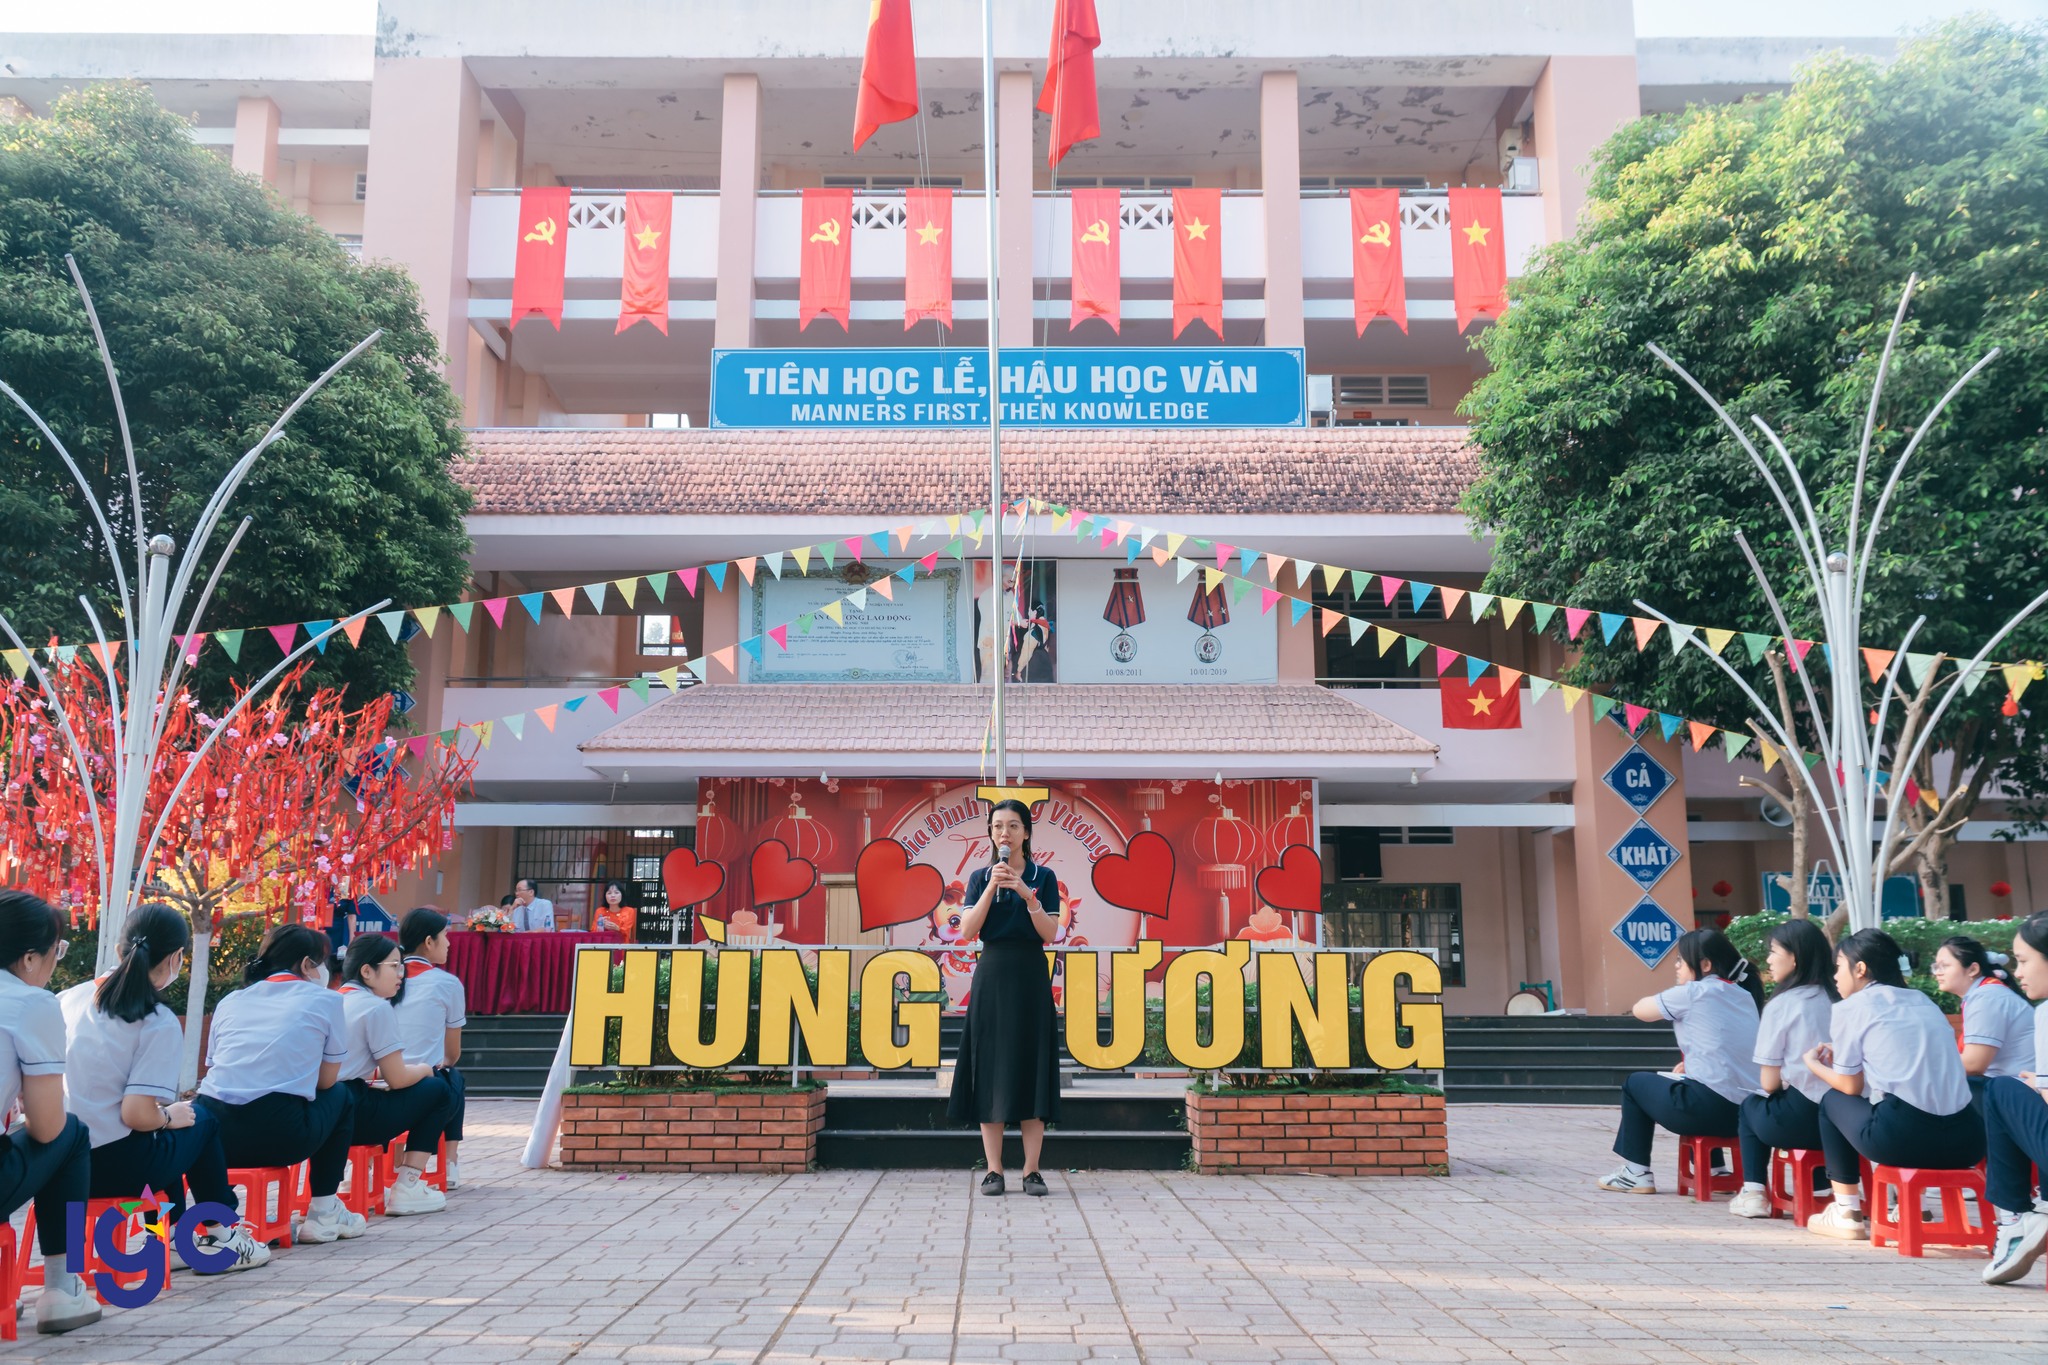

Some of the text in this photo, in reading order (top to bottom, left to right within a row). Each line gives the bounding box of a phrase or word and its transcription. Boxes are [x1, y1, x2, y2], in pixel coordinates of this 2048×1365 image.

[744, 356, 1257, 401] TIÊN HỌC LỄ, HẬU HỌC VĂN
[791, 402, 1209, 423] MANNERS FIRST, THEN KNOWLEDGE
[886, 612, 911, 622] ĐỘNG
[1105, 668, 1142, 677] 10/08/2011
[1190, 667, 1227, 676] 10/01/2019
[1625, 762, 1652, 788] CẢ
[924, 796, 981, 837] Đình
[1048, 800, 1112, 863] Vương
[1621, 841, 1669, 866] KHÁT
[1627, 921, 1672, 945] VỌNG
[570, 912, 1445, 1070] HÙNG ƯƠNG
